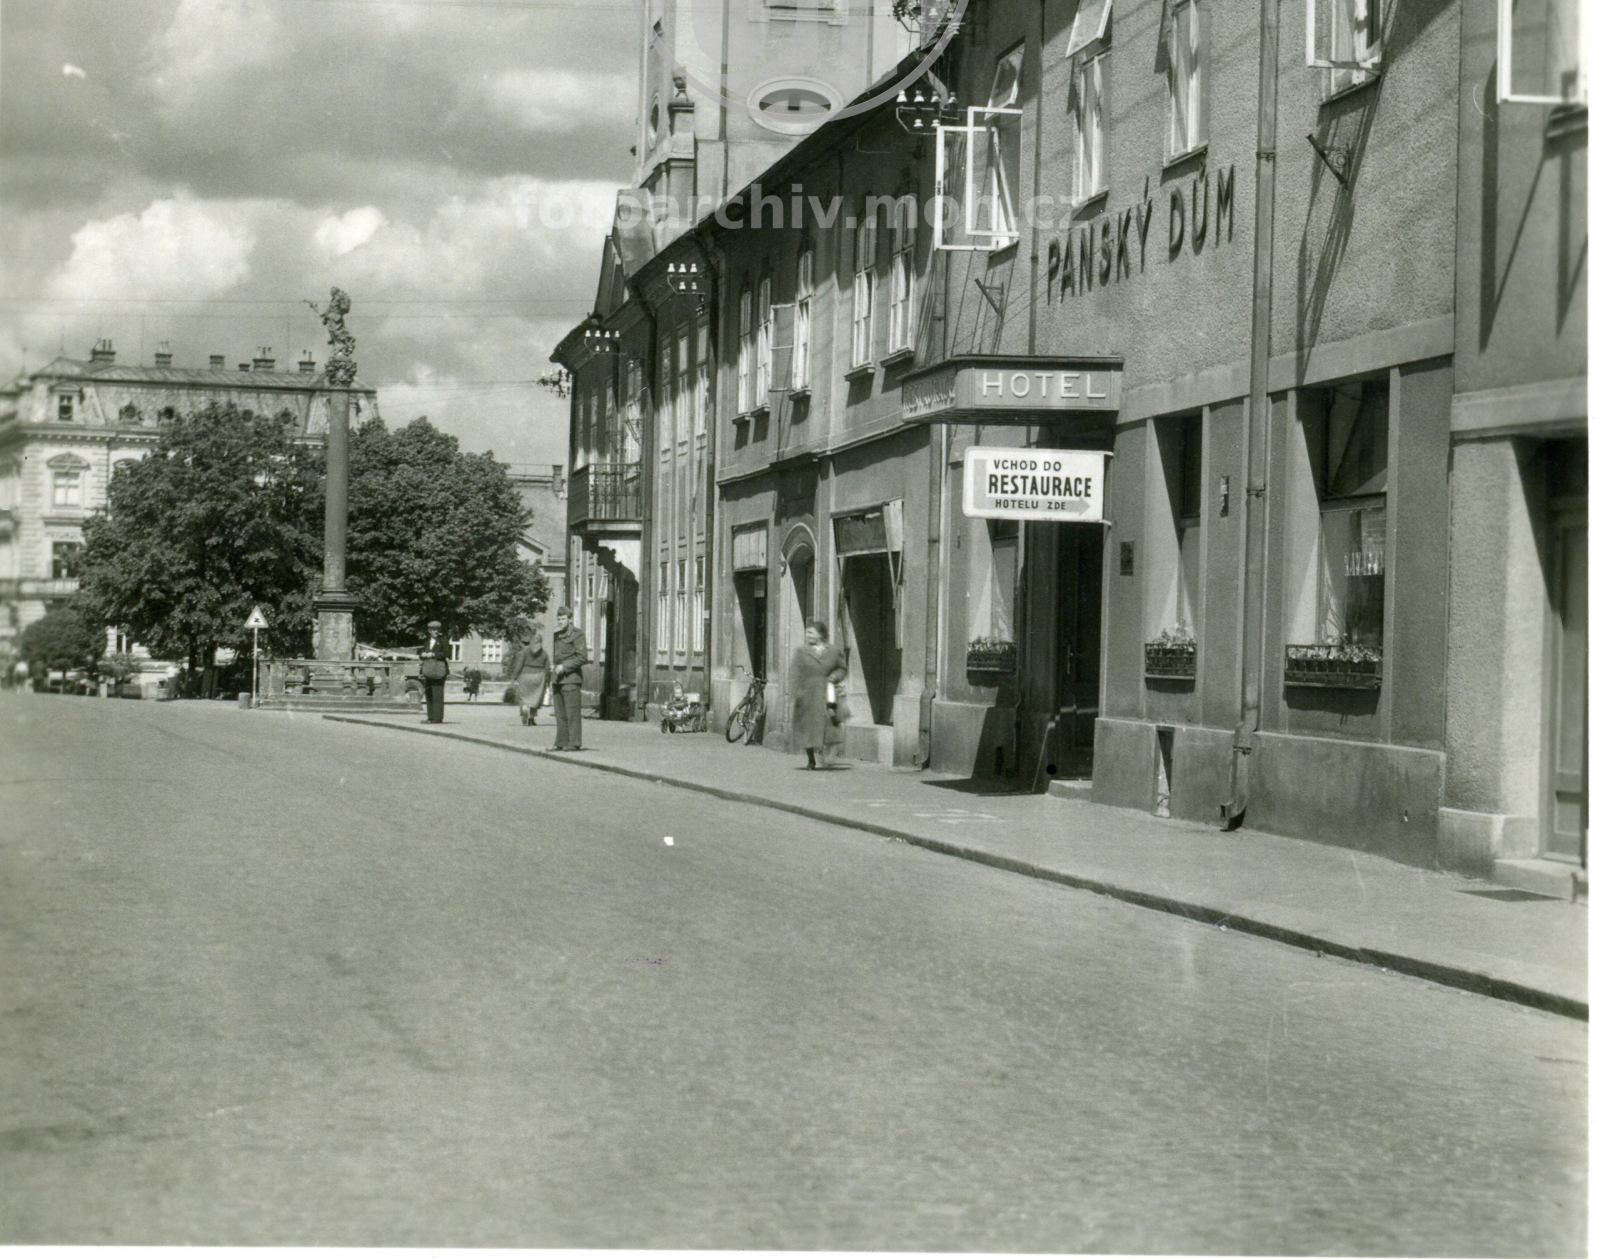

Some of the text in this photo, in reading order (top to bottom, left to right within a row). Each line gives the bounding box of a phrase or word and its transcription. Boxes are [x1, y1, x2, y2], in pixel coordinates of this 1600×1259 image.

[1047, 175, 1153, 307] PANSKÝ
[982, 371, 1106, 399] HOTEL
[993, 459, 1062, 472] VCHOD DO
[988, 474, 1092, 498] RESTAURACE
[995, 499, 1067, 510] HOTELU ZDE
